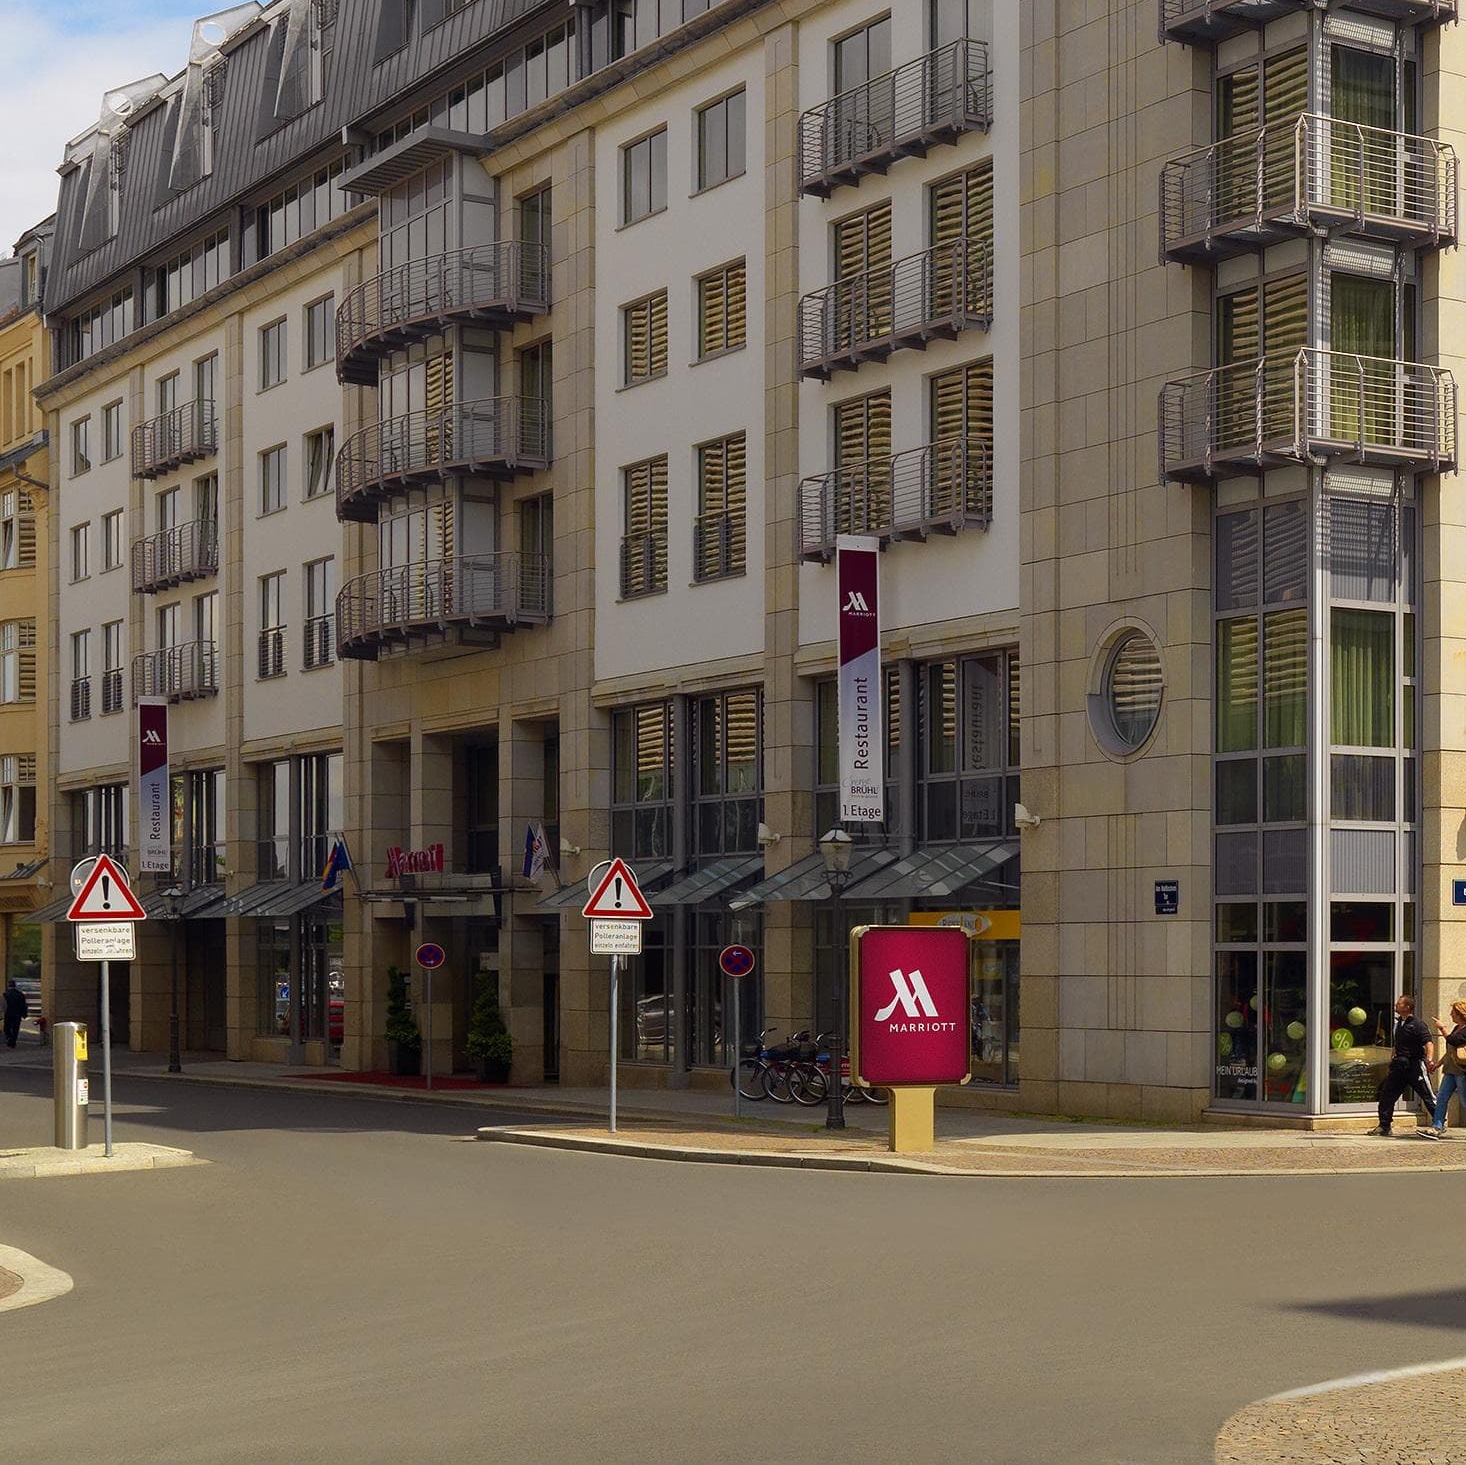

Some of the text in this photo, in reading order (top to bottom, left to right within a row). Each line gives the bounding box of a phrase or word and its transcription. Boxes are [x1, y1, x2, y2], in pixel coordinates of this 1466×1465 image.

[854, 677, 869, 769] Restaurant
[150, 783, 161, 840] Restaurant
[851, 805, 881, 819] Etage
[147, 861, 169, 871] Etage
[889, 1022, 956, 1033] MARRIOTT
